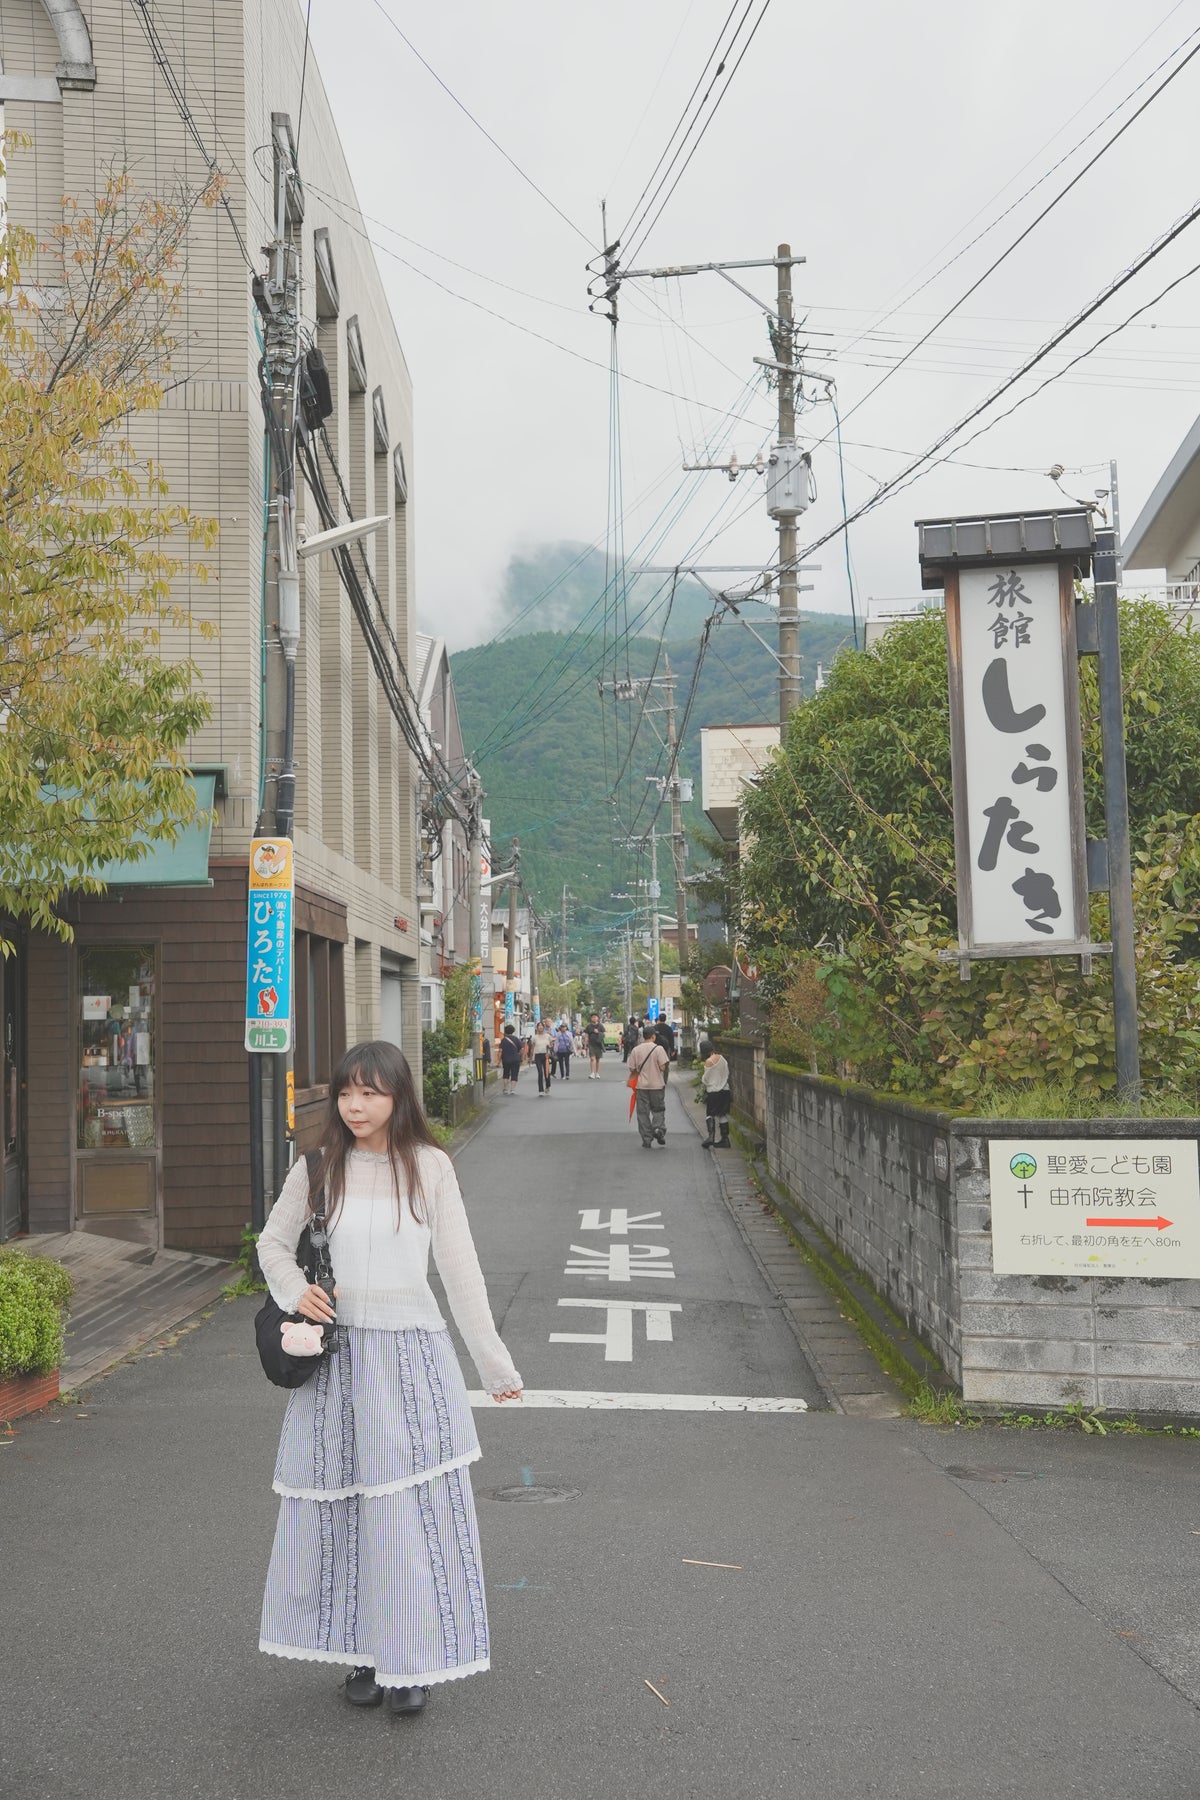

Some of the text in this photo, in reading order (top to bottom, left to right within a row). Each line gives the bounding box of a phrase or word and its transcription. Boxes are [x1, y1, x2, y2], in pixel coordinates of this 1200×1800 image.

[976, 568, 1062, 935] 旅館 しらたき
[252, 901, 275, 984] ひろた
[649, 998, 658, 1009] P
[254, 1034, 278, 1047] 川上
[1047, 1154, 1172, 1175] 聖愛こども園
[1050, 1187, 1157, 1207] 由布院教会
[1020, 1234, 1181, 1248] 右折して、最初の角を左へ80m
[548, 1208, 683, 1362] 止まれ
